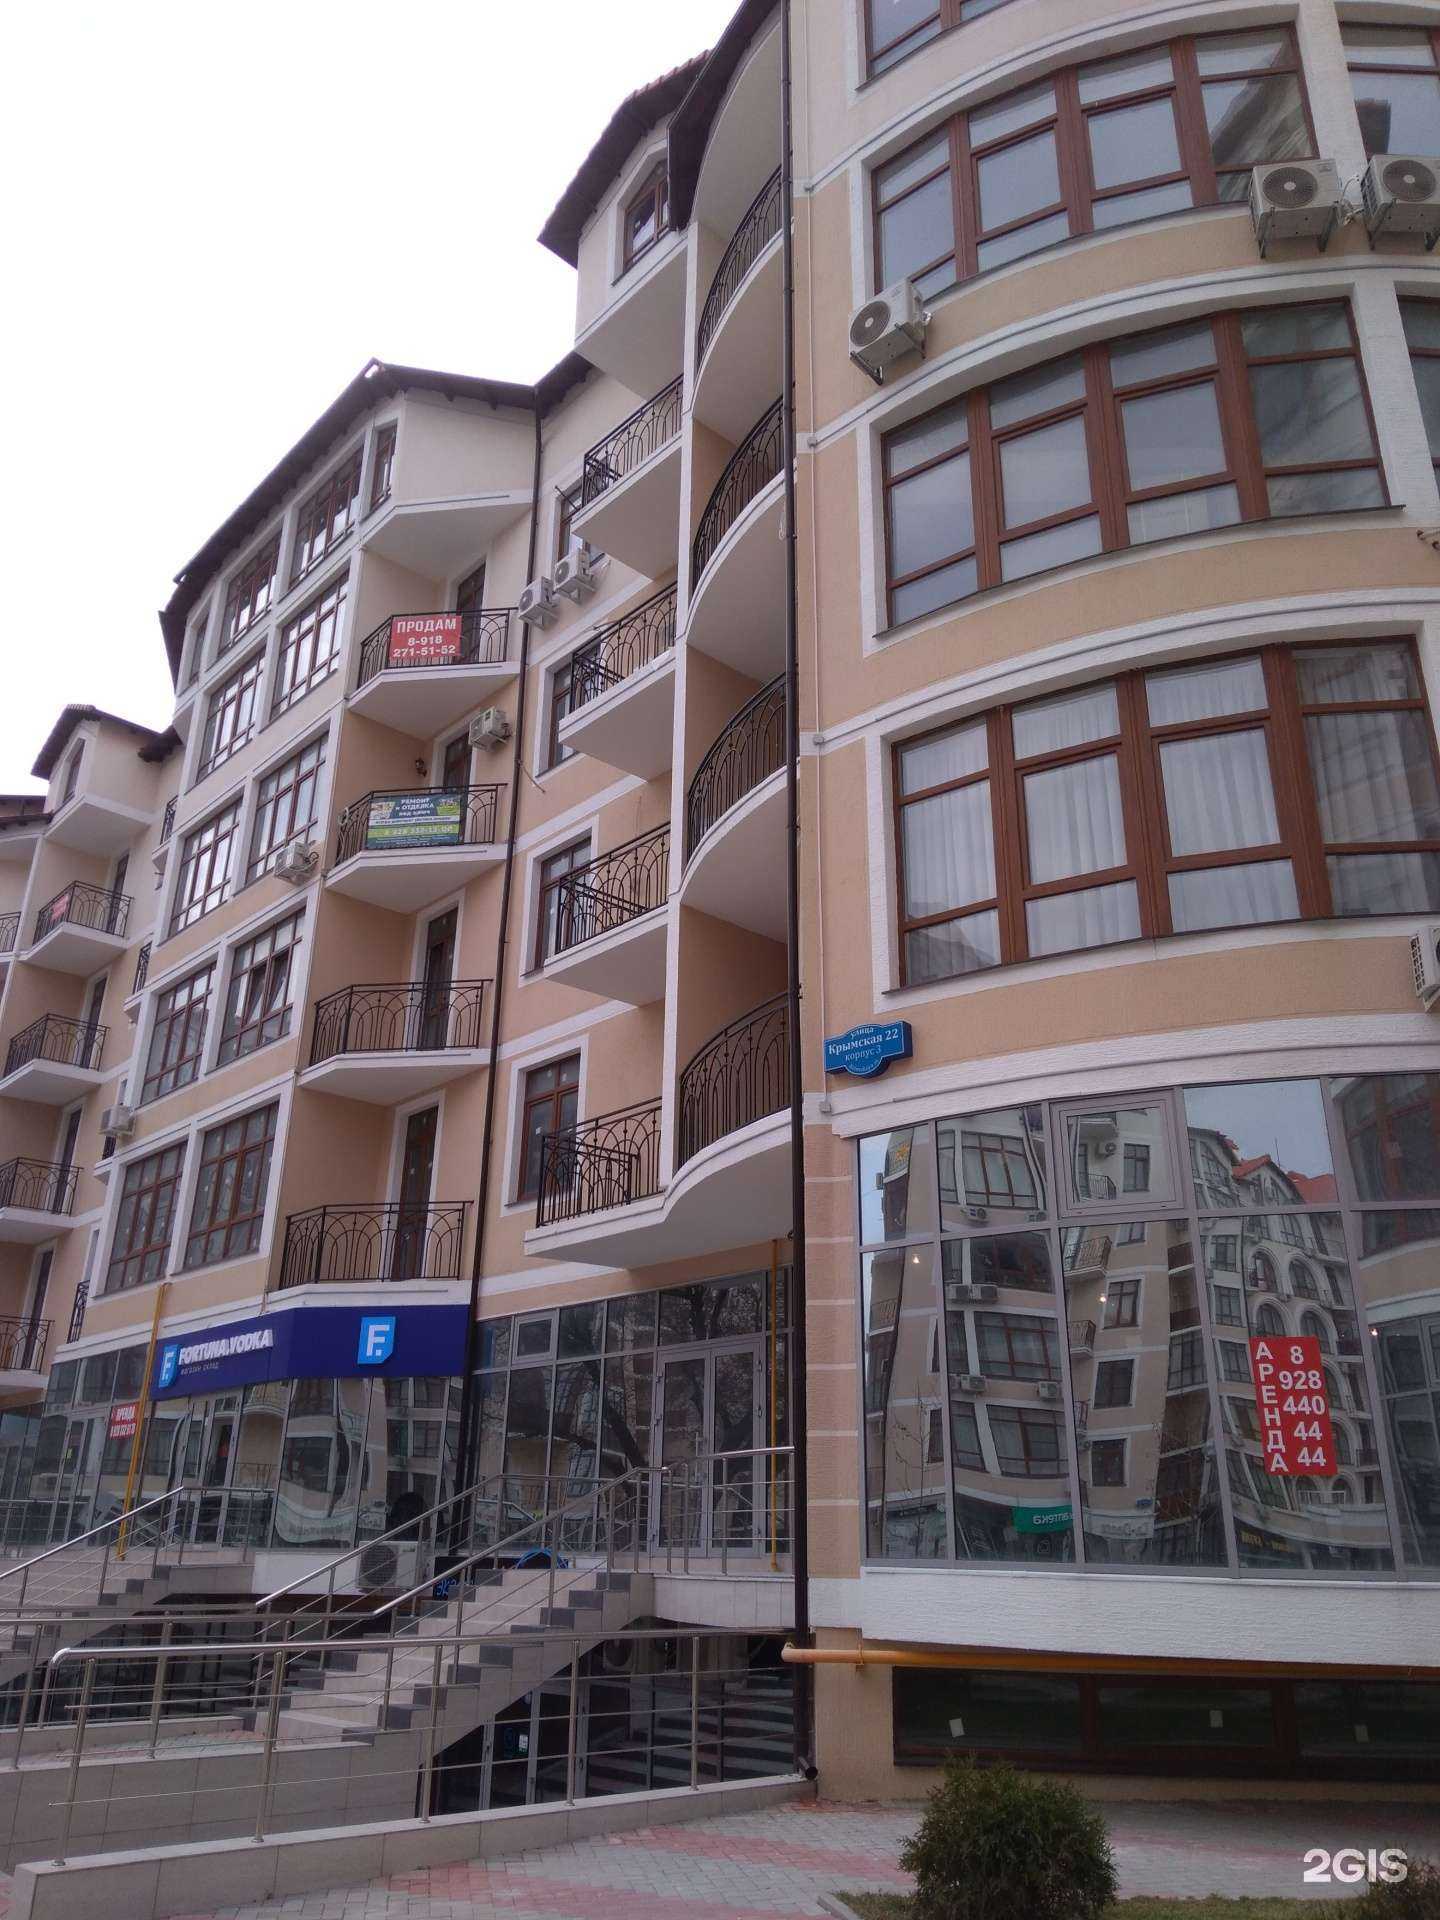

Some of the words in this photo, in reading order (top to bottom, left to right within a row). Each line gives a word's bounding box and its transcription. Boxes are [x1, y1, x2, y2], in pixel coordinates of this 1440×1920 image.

[397, 618, 457, 633] ПРОДАМ
[407, 635, 443, 646] 8-918
[393, 645, 456, 657] 271-51-52
[828, 1034, 883, 1055] Крымская
[885, 1028, 899, 1041] 22
[850, 1027, 874, 1039] улица
[845, 1048, 875, 1062] корпус
[1290, 1345, 1304, 1365] 8
[1278, 1370, 1322, 1390] 928
[1256, 1341, 1289, 1472] АРЕНДА
[1283, 1395, 1326, 1415] 440
[1294, 1421, 1323, 1441] 44
[1297, 1446, 1327, 1467] 44
